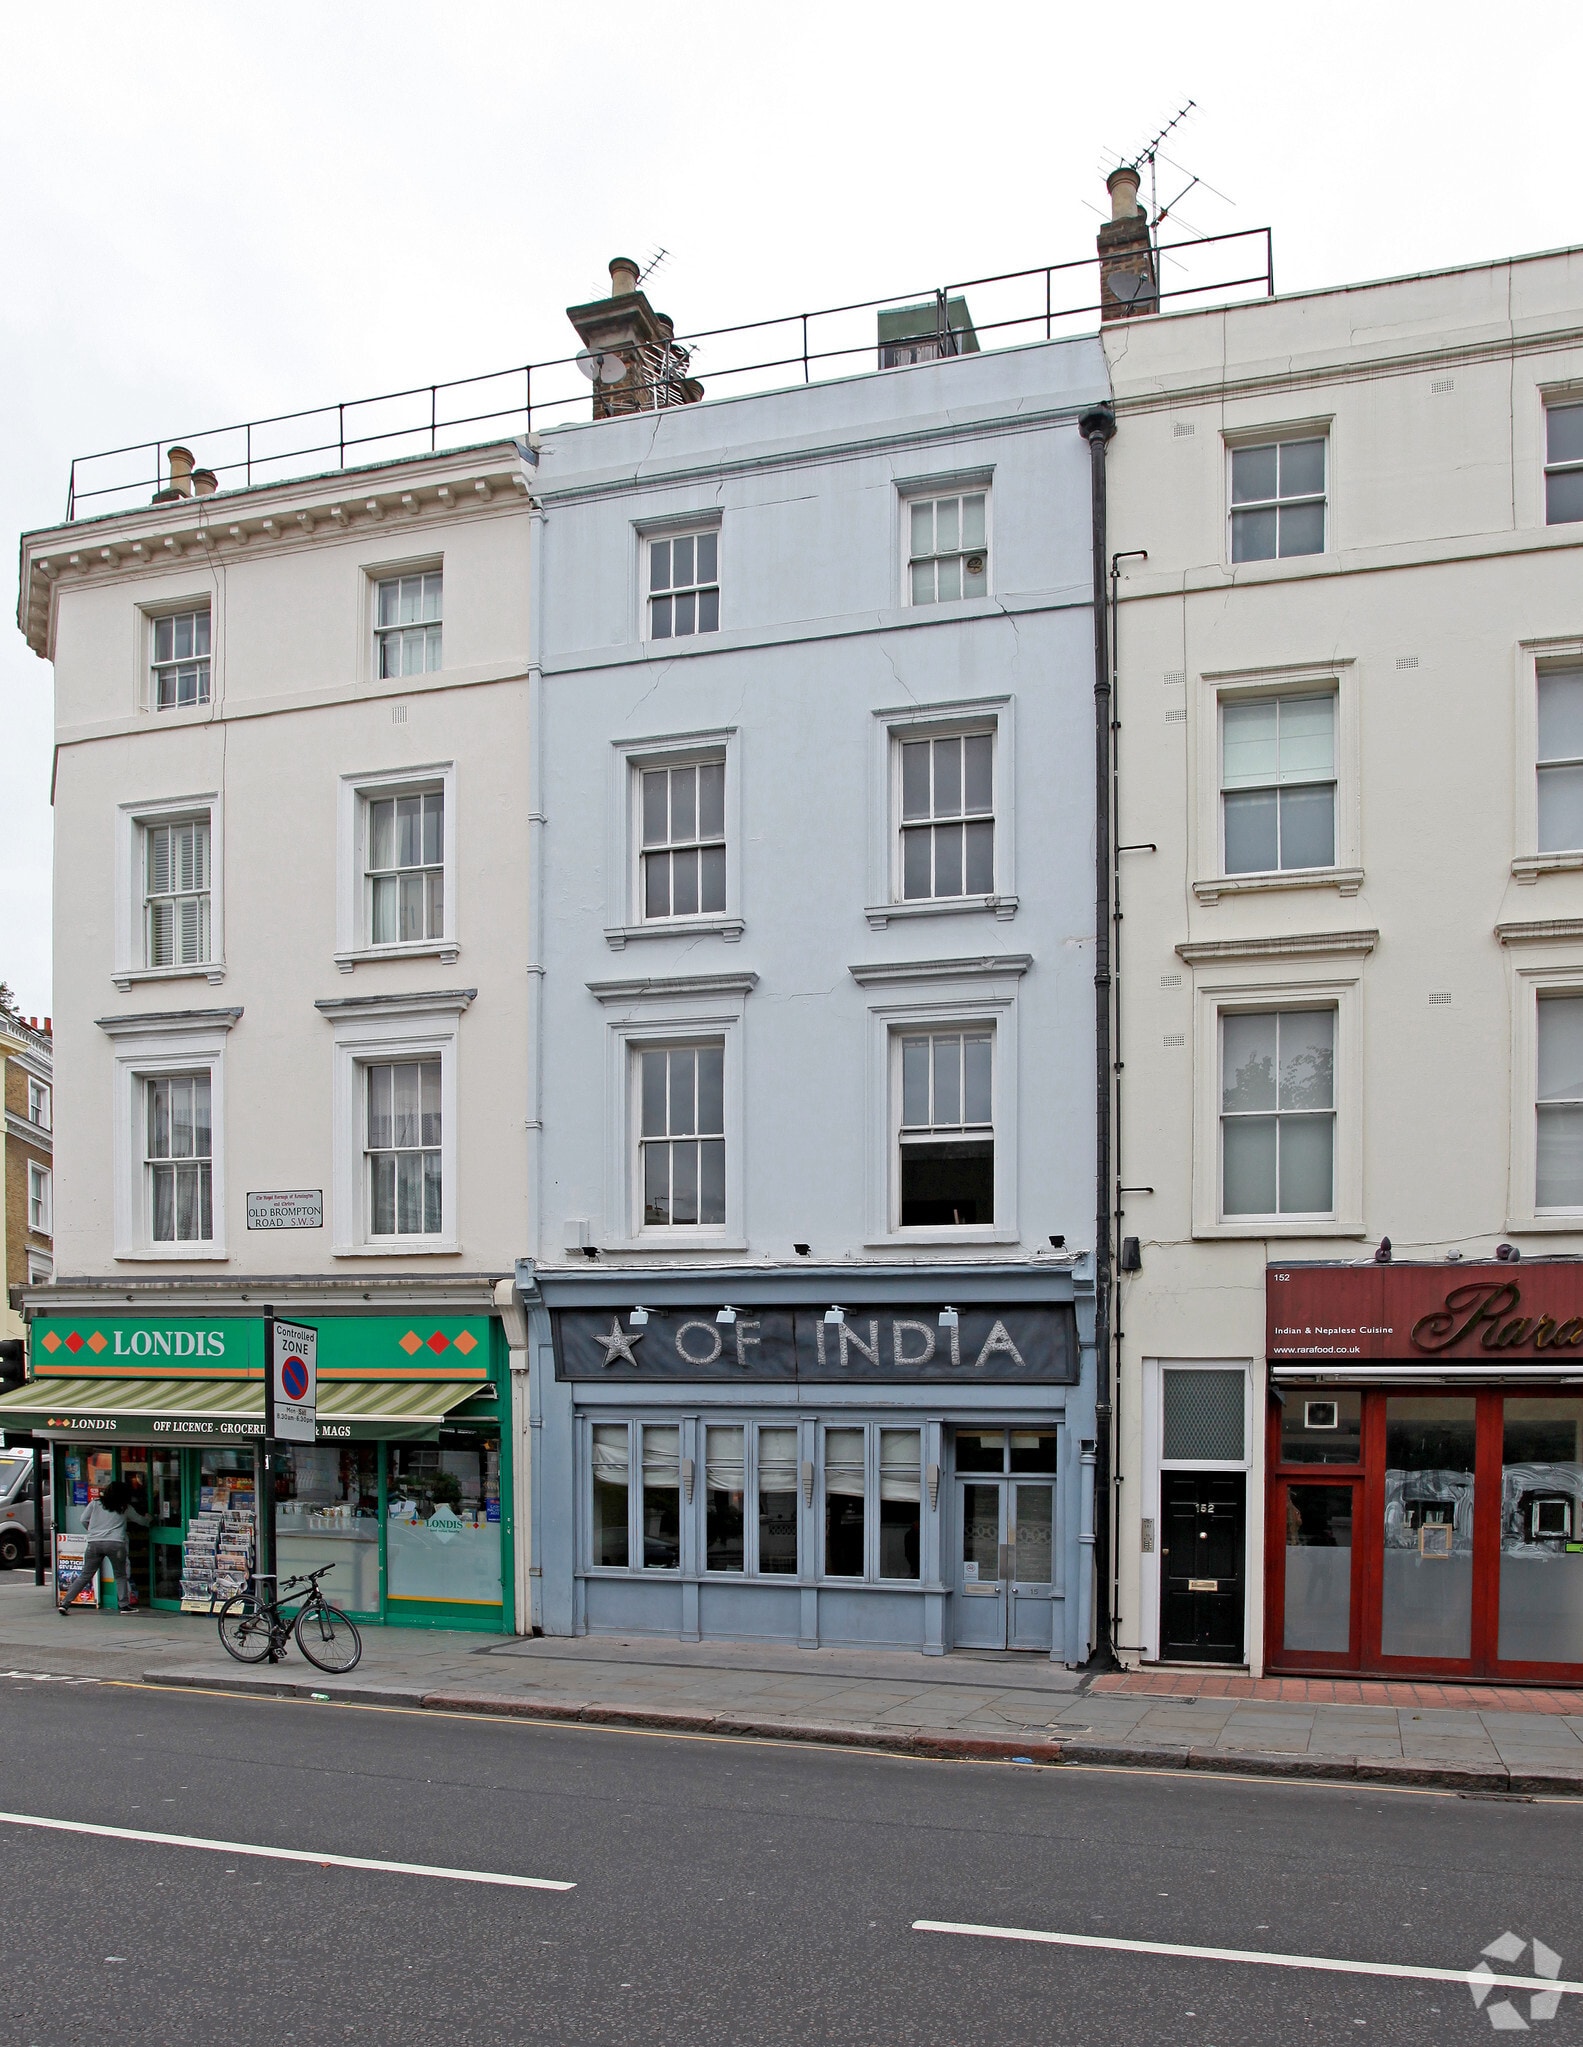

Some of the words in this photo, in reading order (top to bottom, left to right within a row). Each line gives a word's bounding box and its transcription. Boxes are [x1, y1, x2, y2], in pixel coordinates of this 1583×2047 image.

[249, 1208, 267, 1217] OLD
[270, 1206, 320, 1217] BROMPTON
[291, 1217, 315, 1226] S.W.5
[276, 1325, 315, 1342] Controlled
[1274, 1327, 1302, 1335] Indian
[1314, 1326, 1356, 1336] Nepalese
[1359, 1326, 1394, 1334] Cuisine
[113, 1330, 225, 1357] LONDIS
[282, 1339, 309, 1355] ZONE
[675, 1320, 761, 1365] OF
[815, 1319, 1026, 1366] INDIA
[1273, 1345, 1360, 1354] www.rarafood.co.uk
[71, 1418, 117, 1430] LONDIS
[153, 1420, 171, 1431] OFF
[173, 1421, 213, 1433] LICENCE
[322, 1425, 351, 1437] MAGS
[1195, 1503, 1215, 1513] 152
[426, 1519, 463, 1529] LONDIS
